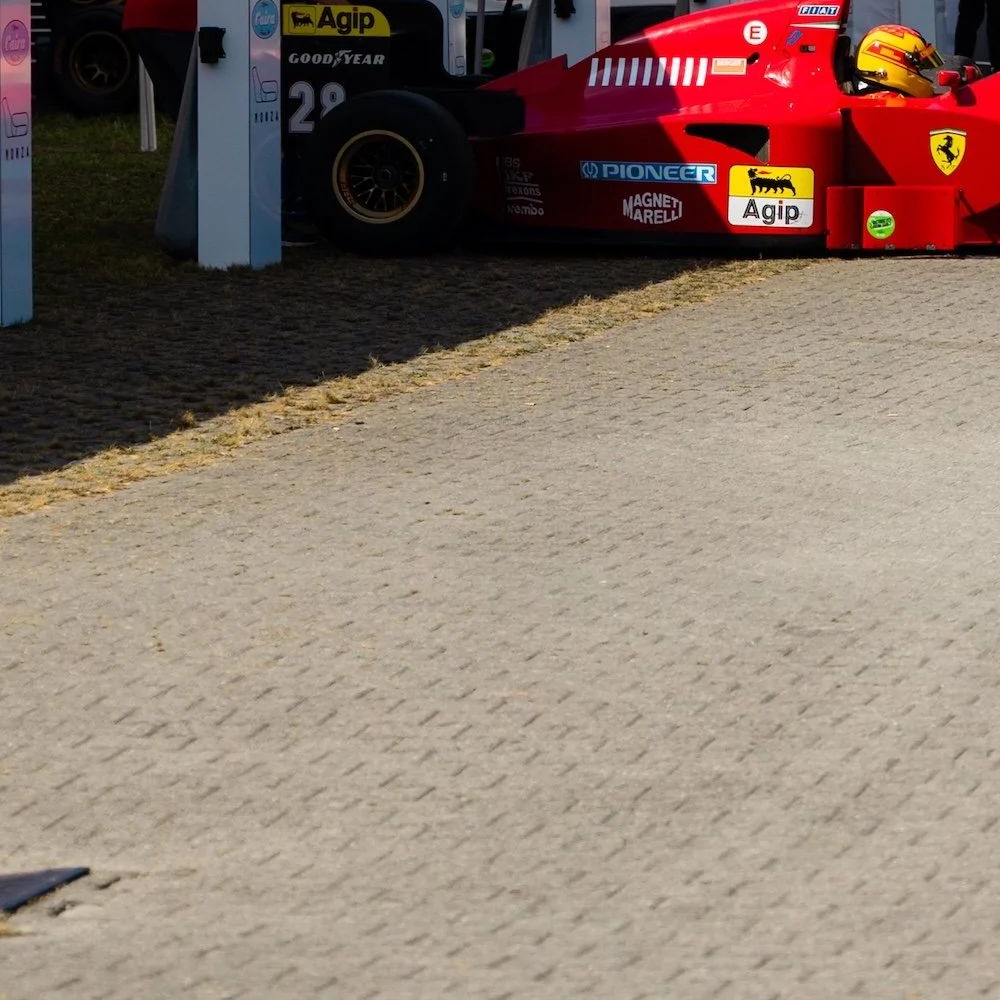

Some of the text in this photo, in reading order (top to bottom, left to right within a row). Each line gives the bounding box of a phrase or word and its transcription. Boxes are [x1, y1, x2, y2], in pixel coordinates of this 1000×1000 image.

[317, 6, 375, 35] Agip
[800, 6, 838, 15] FIAT
[750, 26, 761, 40] E
[288, 50, 386, 68] GOODYEAR
[602, 163, 716, 183] PIONEER
[623, 192, 682, 212] MAGNETI
[742, 199, 801, 225] Agip
